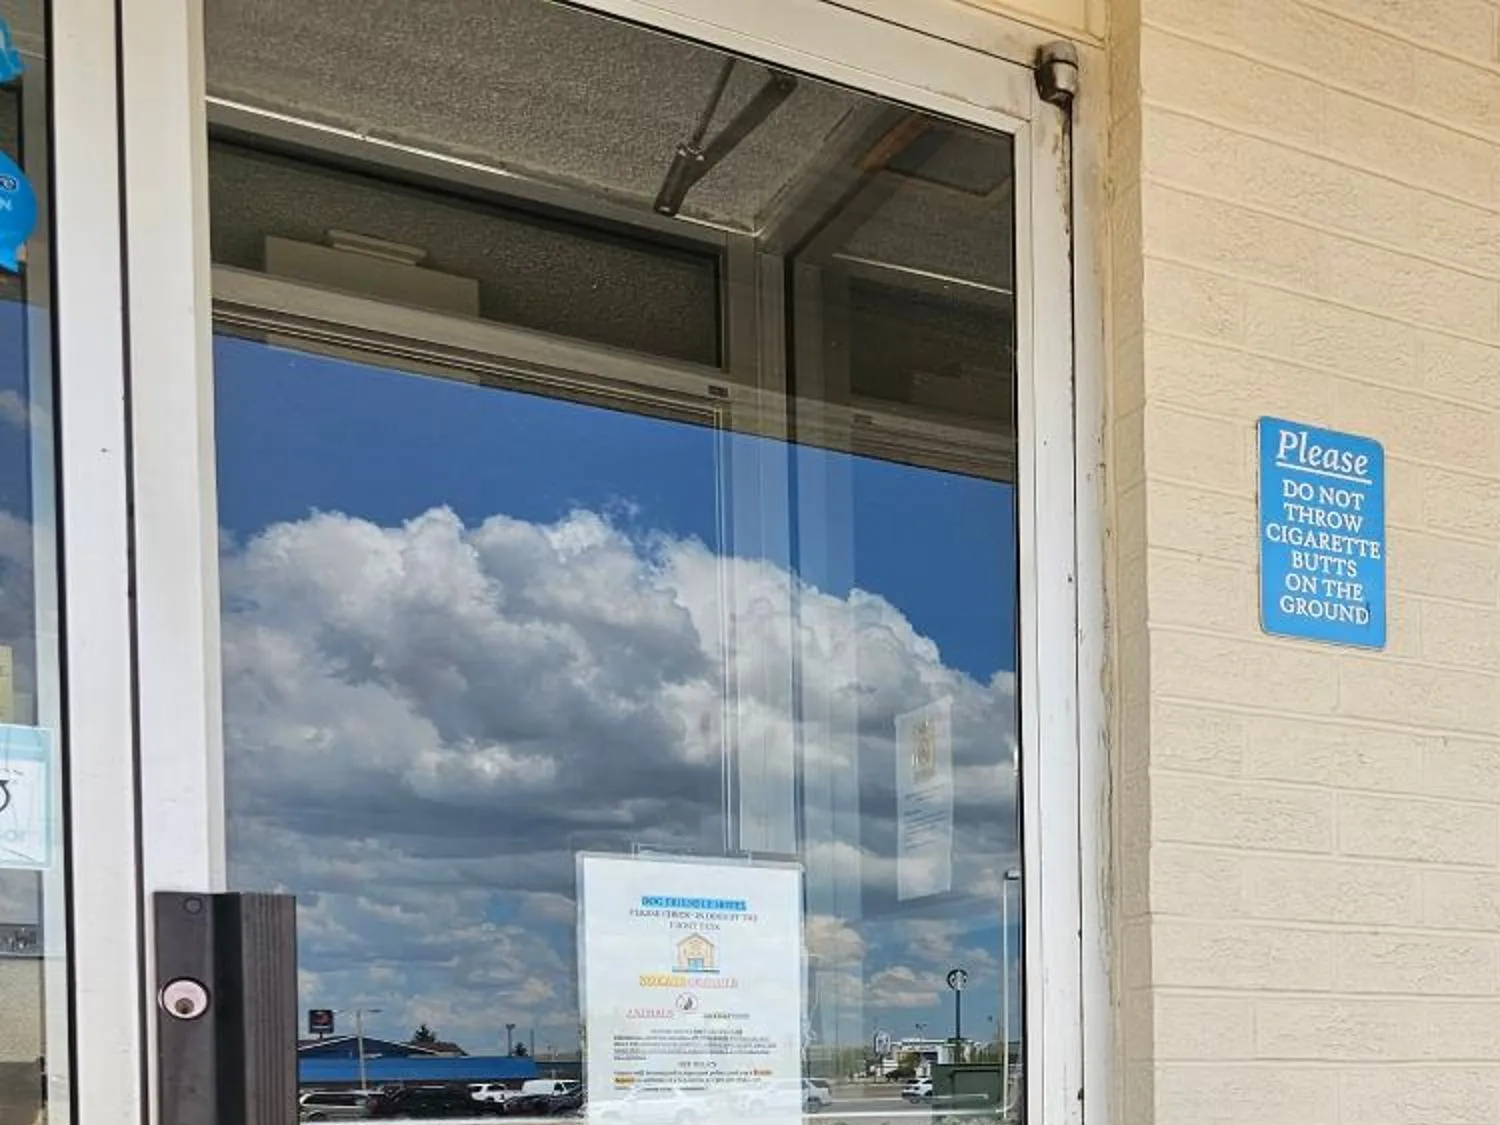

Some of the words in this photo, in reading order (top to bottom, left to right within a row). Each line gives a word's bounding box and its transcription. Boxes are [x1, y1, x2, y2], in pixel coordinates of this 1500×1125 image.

[1277, 429, 1369, 475] Please
[1282, 479, 1314, 500] DO
[1319, 486, 1365, 511] NOT
[1283, 503, 1363, 533] THROW
[1266, 523, 1381, 560] CIGARETTE
[1291, 551, 1357, 577] BUTTS
[1285, 573, 1318, 595] ON
[1322, 579, 1364, 602] THE
[1279, 595, 1370, 625] GROUND
